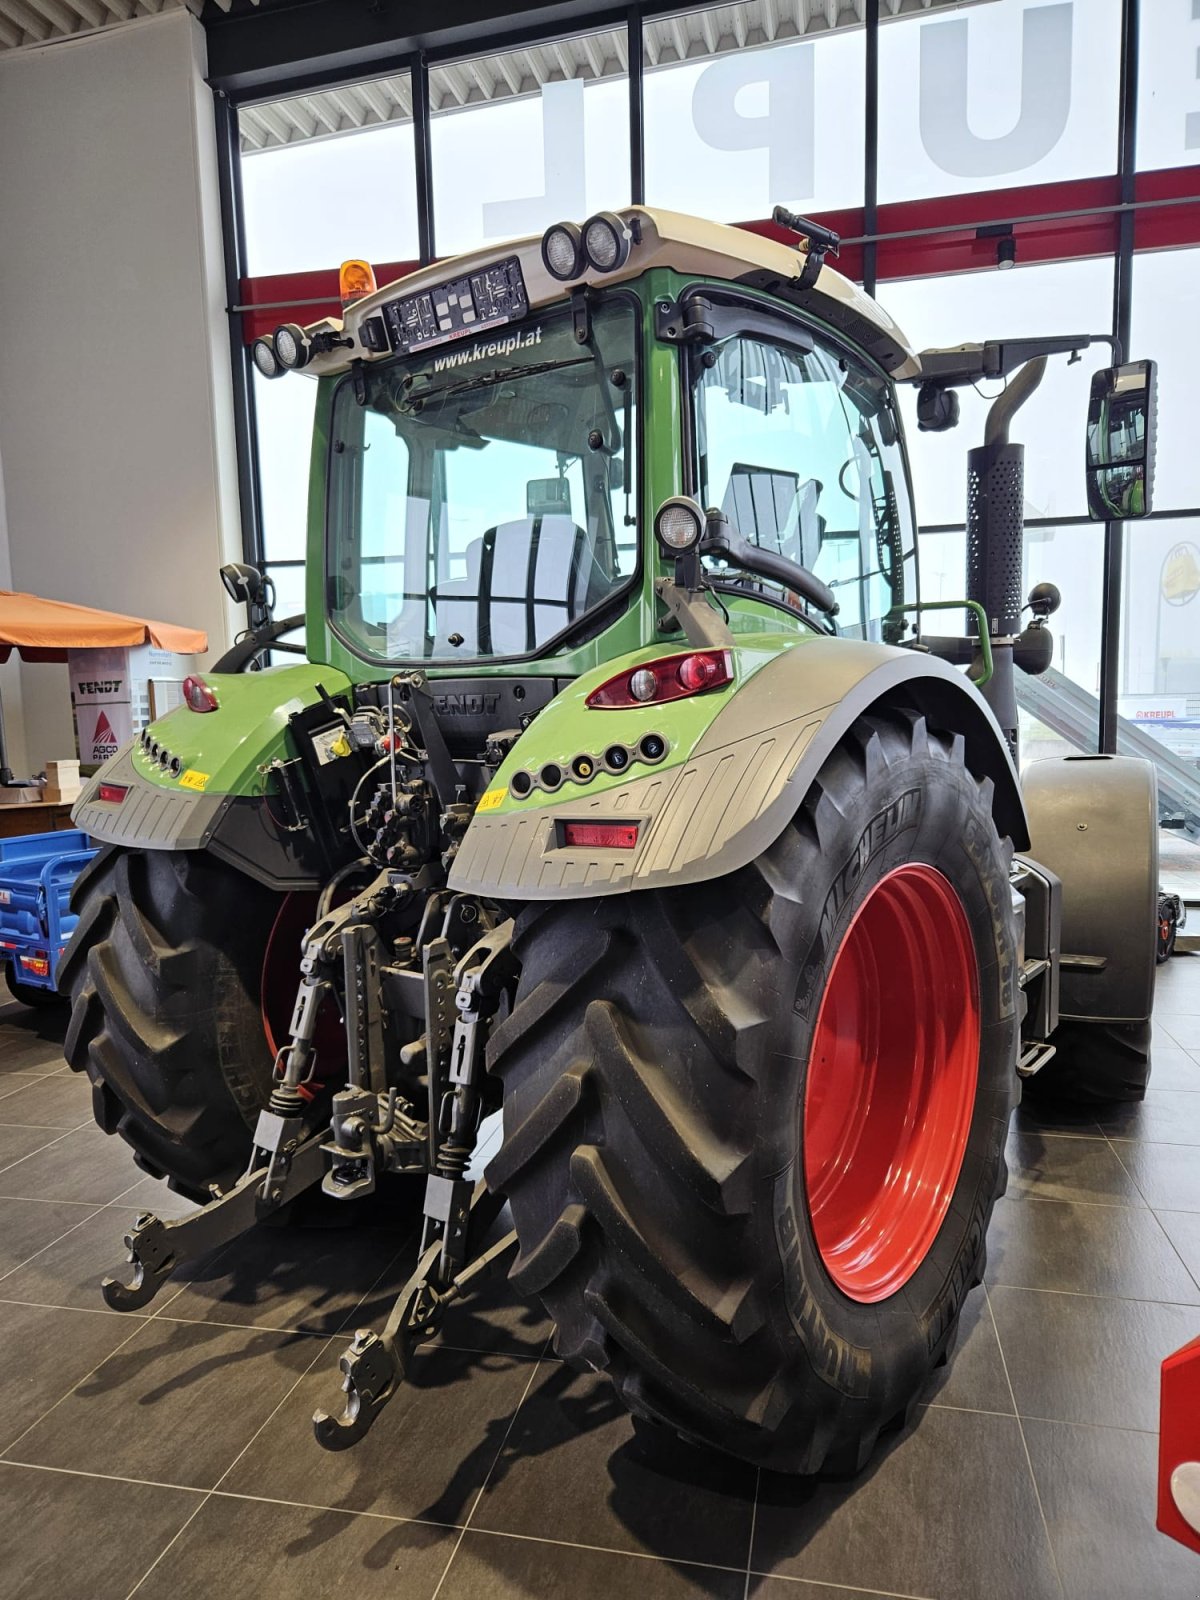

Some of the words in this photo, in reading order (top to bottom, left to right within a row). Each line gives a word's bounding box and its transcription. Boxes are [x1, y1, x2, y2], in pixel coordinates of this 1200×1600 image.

[434, 326, 542, 372] www.kreupl.at
[78, 680, 122, 694] FENDT
[431, 693, 501, 717] ENDT
[1144, 710, 1175, 719] KREUPL
[92, 745, 118, 753] AGCO
[820, 788, 921, 947] MICHELIN
